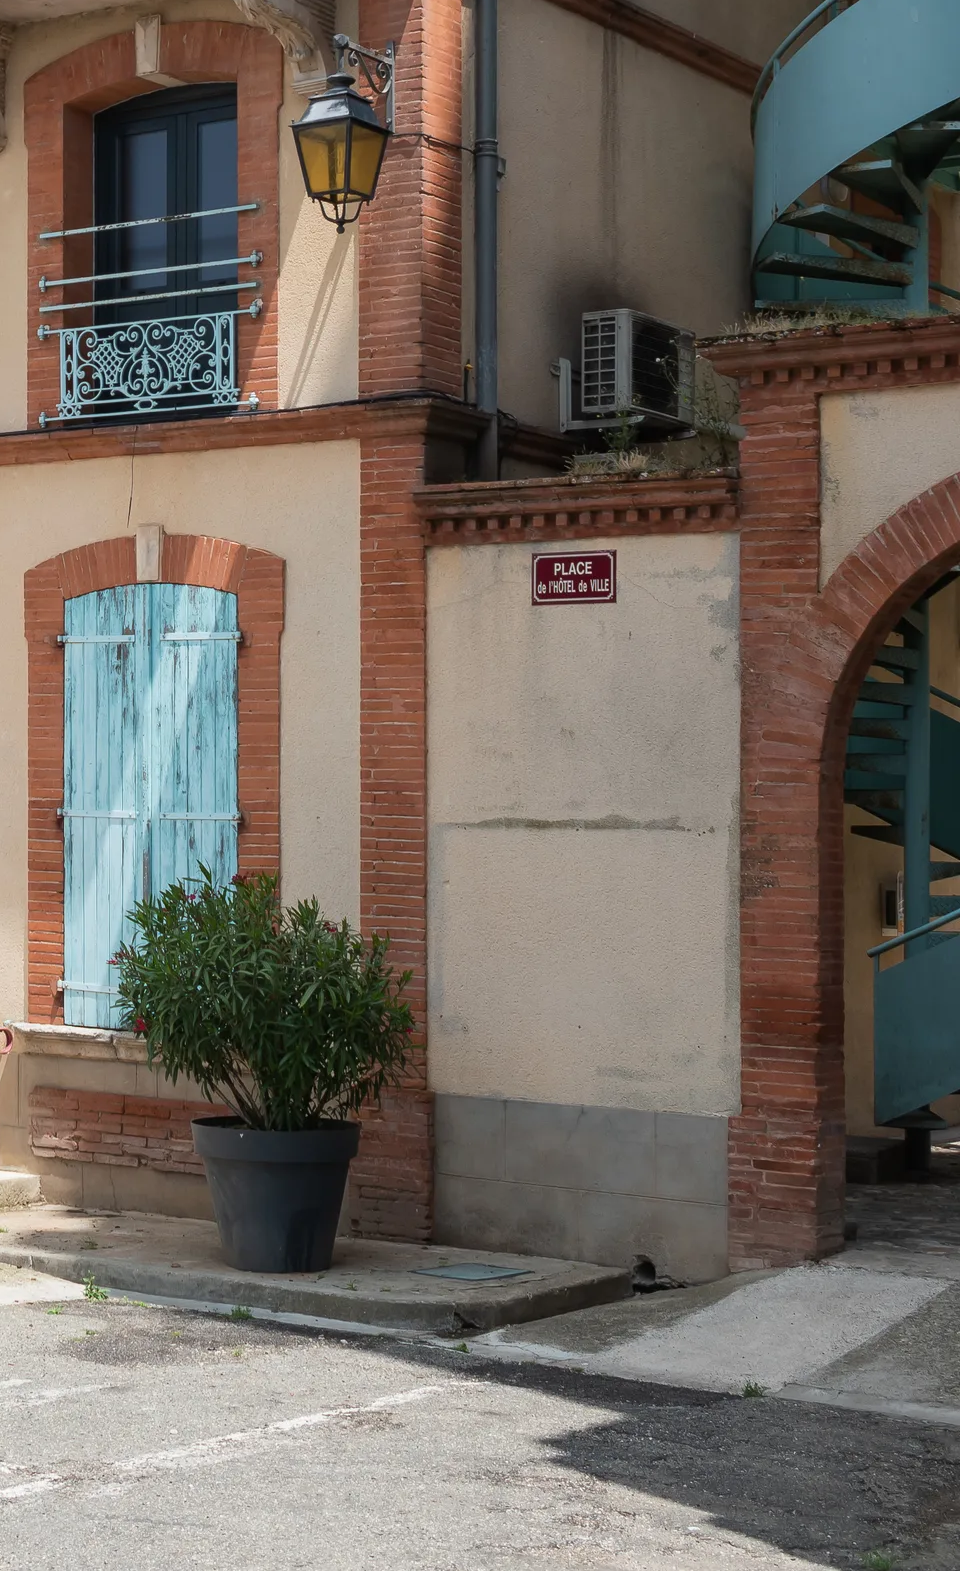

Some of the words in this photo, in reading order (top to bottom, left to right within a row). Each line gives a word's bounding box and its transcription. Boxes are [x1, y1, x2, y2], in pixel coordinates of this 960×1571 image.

[554, 561, 593, 576] PLACE
[537, 581, 547, 594] de
[548, 577, 576, 594] l'HÔTEL
[578, 579, 588, 592] de
[590, 578, 610, 592] VILLE
